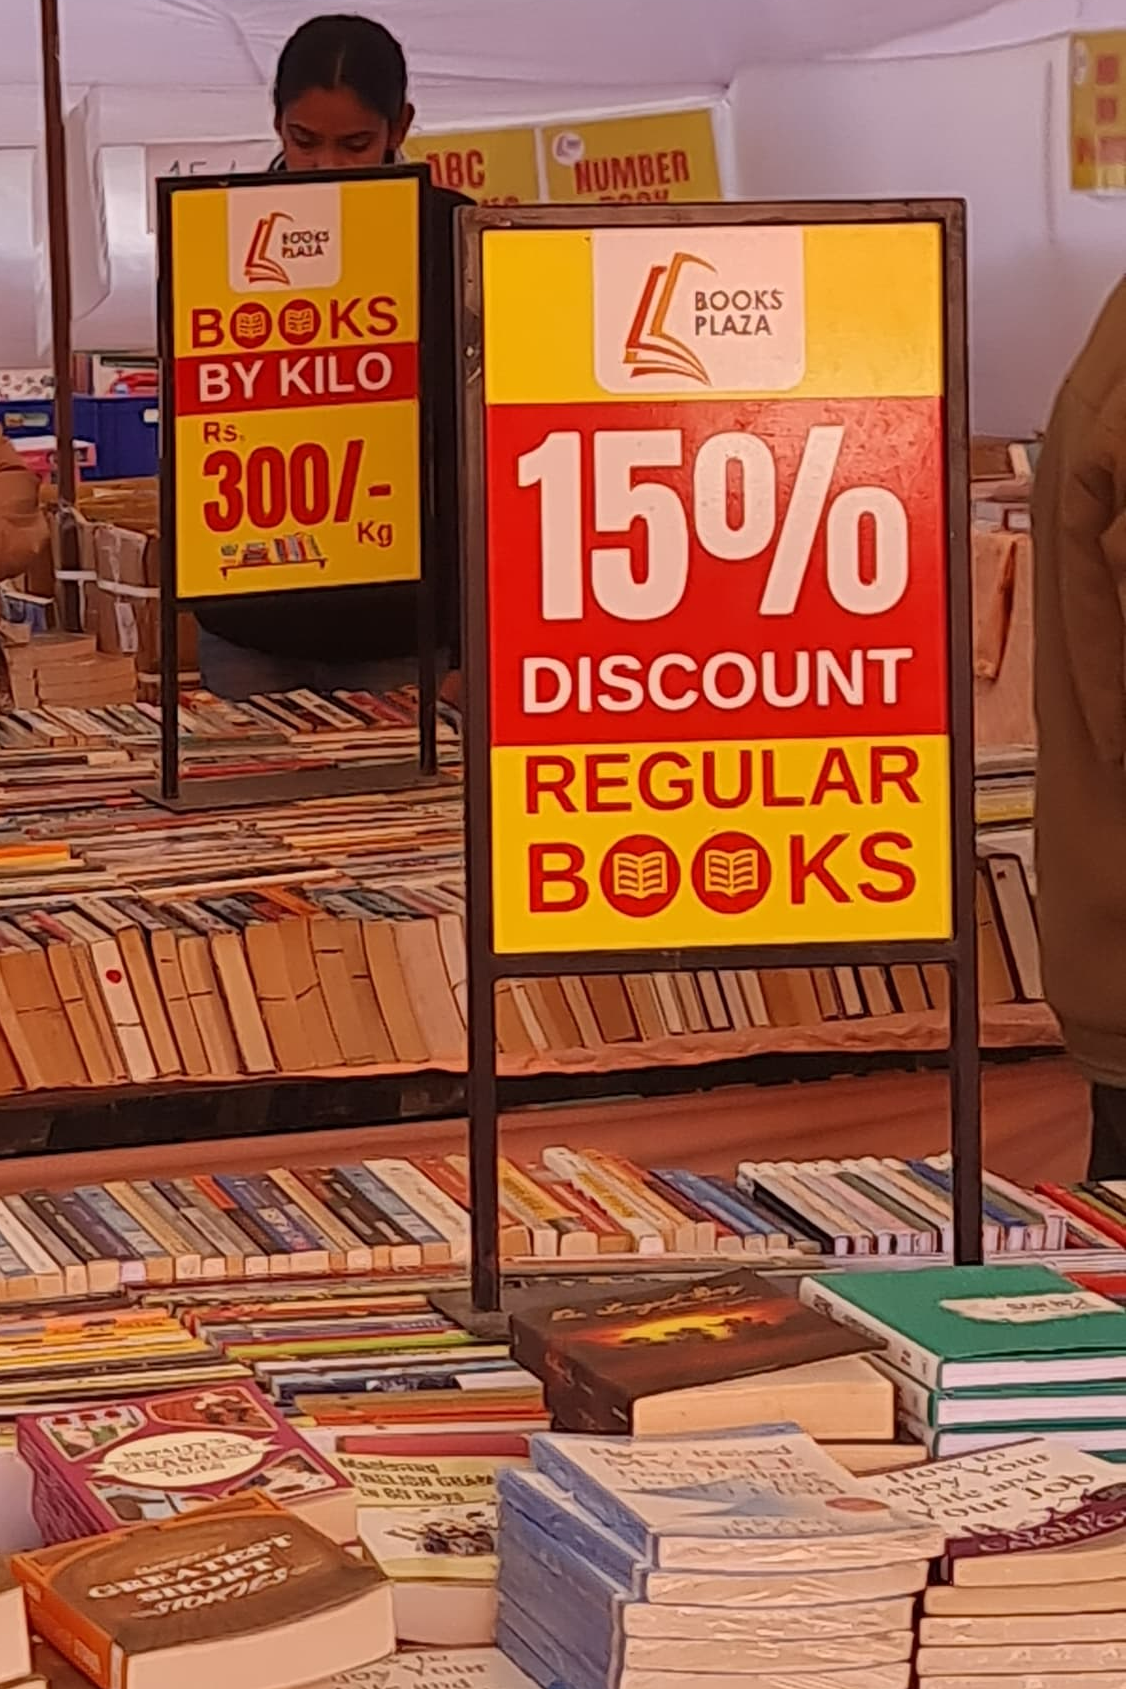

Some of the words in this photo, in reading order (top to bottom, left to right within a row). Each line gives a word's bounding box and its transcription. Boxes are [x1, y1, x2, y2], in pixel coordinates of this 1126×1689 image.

[574, 149, 691, 196] NUMBER
[281, 230, 330, 245] BOOKS
[281, 244, 324, 259] PLAZA
[191, 296, 399, 350] BOOKS
[693, 288, 785, 312] BOOKS
[693, 313, 774, 337] PLAZA
[198, 360, 265, 404] BY
[279, 352, 393, 397] KILO
[203, 421, 246, 444] Rs.
[202, 438, 393, 534] 300/-
[357, 521, 394, 548] Kg
[517, 424, 910, 622] 15%
[521, 647, 914, 715] DISCOUNT
[525, 745, 922, 815] REGULAR
[528, 830, 917, 918] BOOKS
[884, 1461, 965, 1484] How
[964, 1453, 1051, 1477] Your
[989, 1470, 1048, 1493] and
[907, 1496, 1014, 1521] Your
[1022, 1473, 1097, 1500] Job
[88, 1533, 293, 1599] GREATEST
[136, 1557, 274, 1603] SHORT
